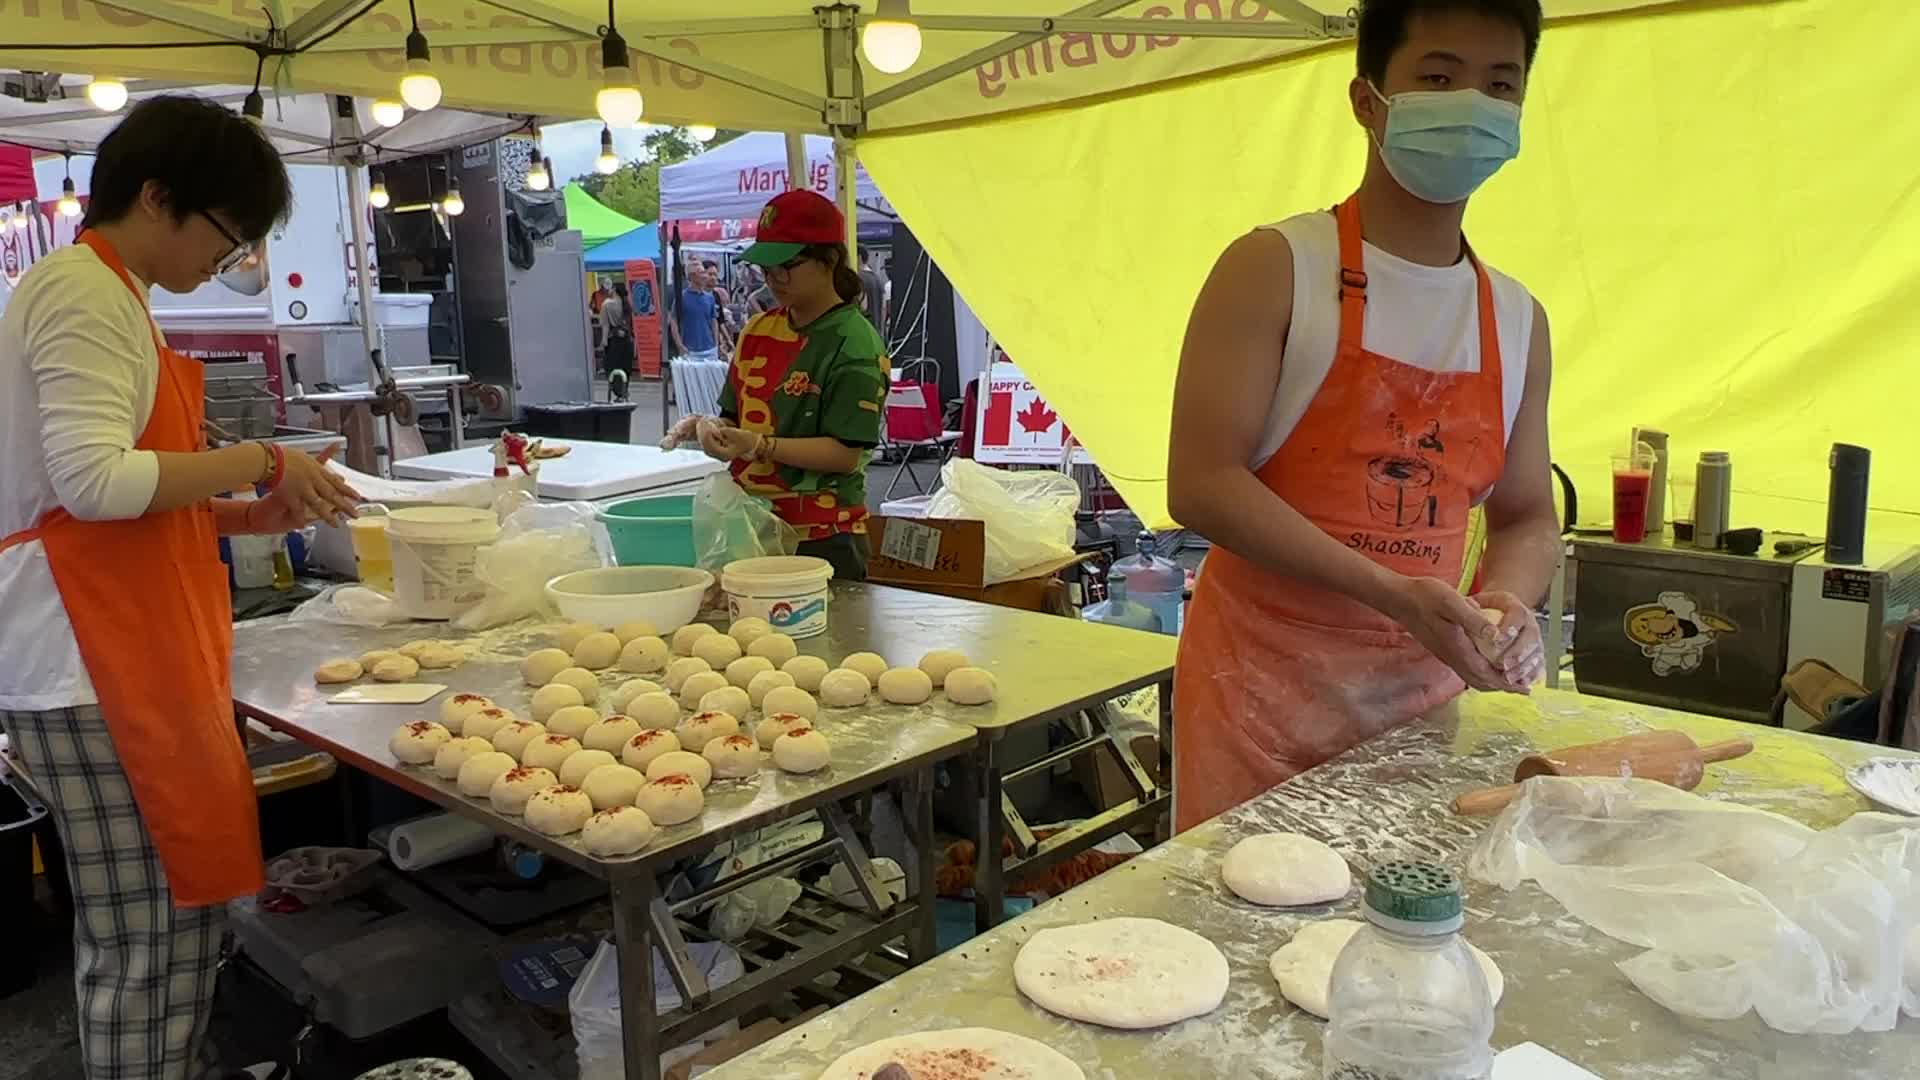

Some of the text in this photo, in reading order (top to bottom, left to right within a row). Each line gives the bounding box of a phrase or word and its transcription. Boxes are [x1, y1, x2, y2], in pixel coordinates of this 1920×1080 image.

[738, 167, 791, 194] Mary
[991, 381, 1020, 391] APPY
[1346, 532, 1441, 565] ShaoBing
